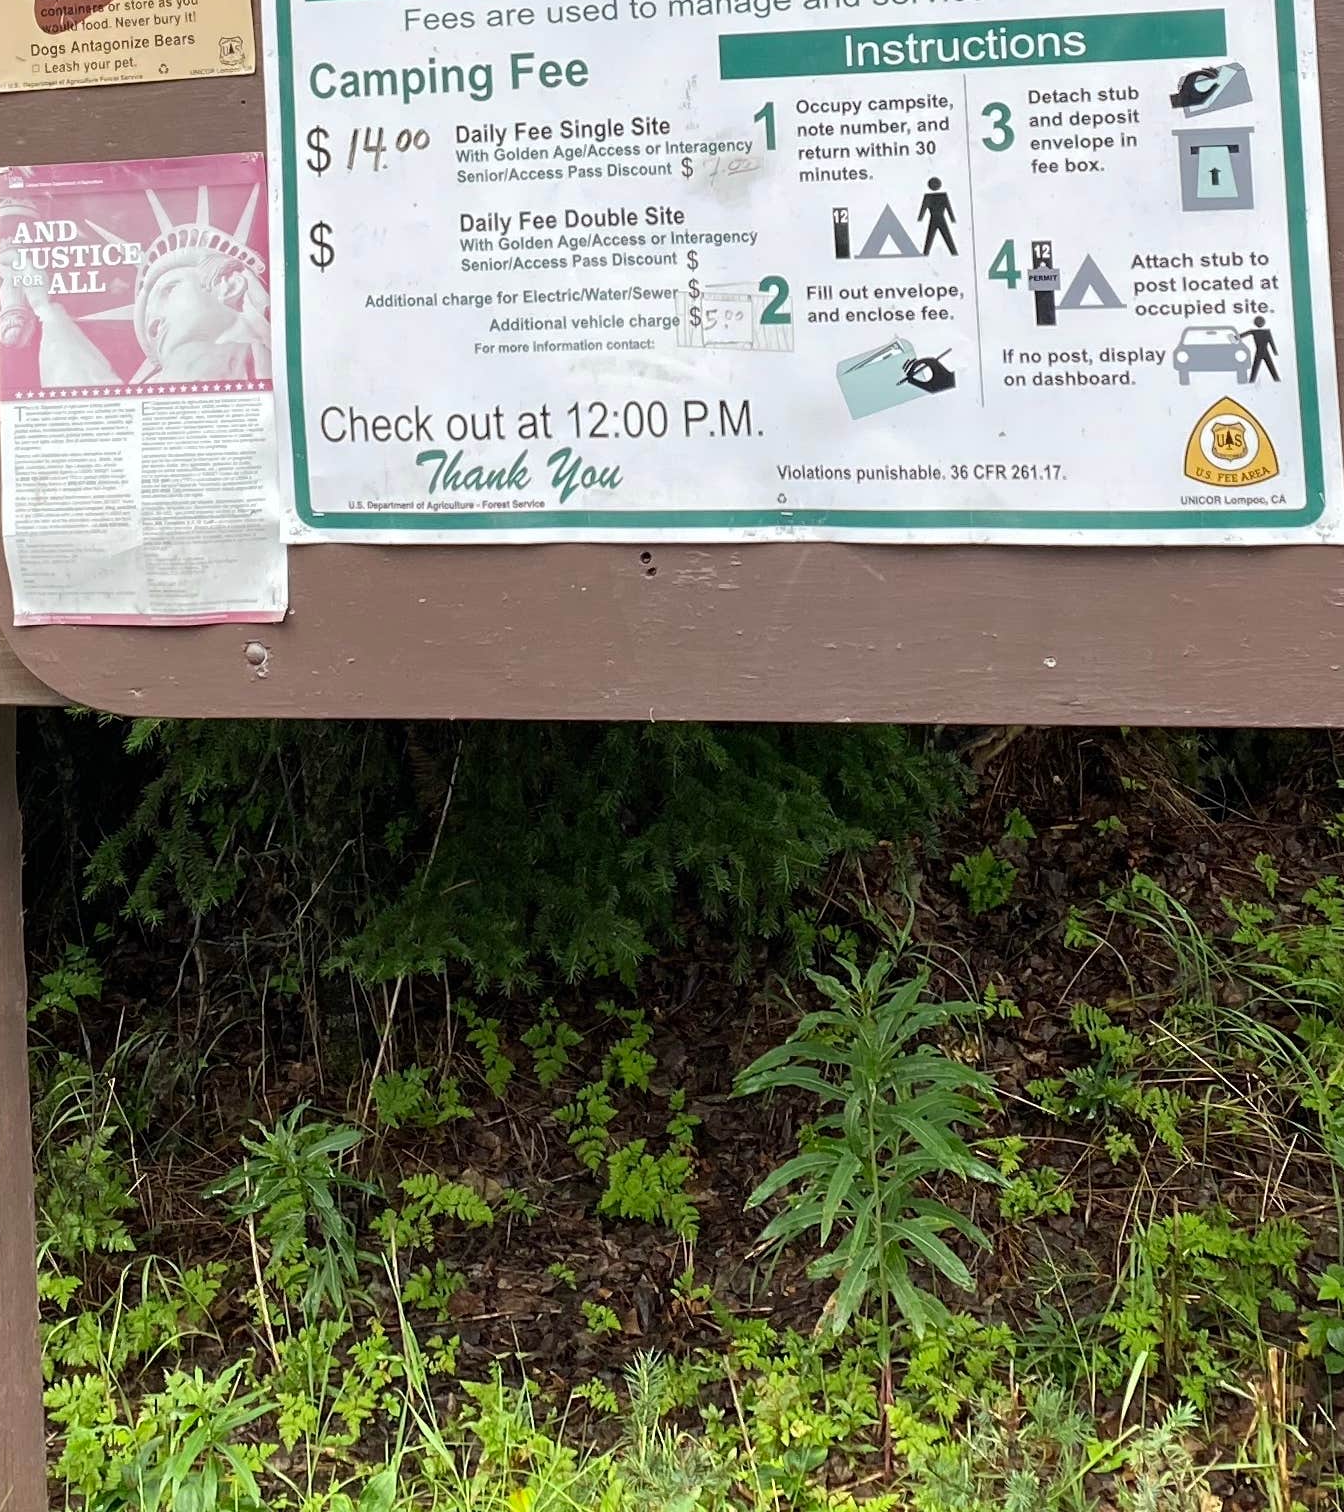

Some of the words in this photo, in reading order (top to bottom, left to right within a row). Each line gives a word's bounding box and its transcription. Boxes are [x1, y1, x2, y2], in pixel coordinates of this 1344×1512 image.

[404, 6, 475, 32] Fees
[487, 8, 535, 26] are
[31, 43, 66, 59] Dogs
[71, 36, 150, 54] Antagonize
[154, 33, 196, 48] Bears
[845, 28, 1087, 67] Instructions
[44, 61, 80, 74] Leash
[84, 59, 110, 73] your
[114, 57, 138, 70] pet.
[309, 57, 493, 104] Camping
[510, 52, 589, 89] Fee
[456, 123, 506, 147] Daily
[514, 121, 553, 141] Fee
[560, 117, 625, 144] Single
[631, 117, 671, 138] Site
[305, 125, 332, 178] $
[456, 149, 491, 164] With
[494, 146, 550, 162] Golden
[553, 142, 642, 161] Age/Access
[645, 144, 662, 155] or
[665, 138, 753, 159] Interagency
[12, 220, 79, 244] AND
[12, 243, 142, 271] JUSTICE
[12, 275, 43, 287] FOR
[48, 271, 106, 295] ALL
[320, 405, 433, 443] Check
[446, 407, 507, 441] out
[517, 405, 552, 440] at
[567, 400, 669, 440] 12:00
[683, 399, 765, 438] P.M.
[415, 449, 533, 494] Thank
[547, 447, 623, 504] You
[777, 464, 851, 482] Violations
[856, 464, 946, 484] punishable.
[951, 464, 969, 480] 36
[973, 464, 1007, 480] CFR
[1011, 464, 1068, 481] 261.17.
[349, 502, 365, 510] U.S.
[367, 501, 414, 511] Department
[416, 501, 425, 509] of
[427, 501, 474, 512] Agriculture
[482, 501, 510, 509] Forest
[512, 500, 545, 509] Service
[1181, 496, 1221, 504] UNICOR
[1271, 494, 1287, 504] CA
